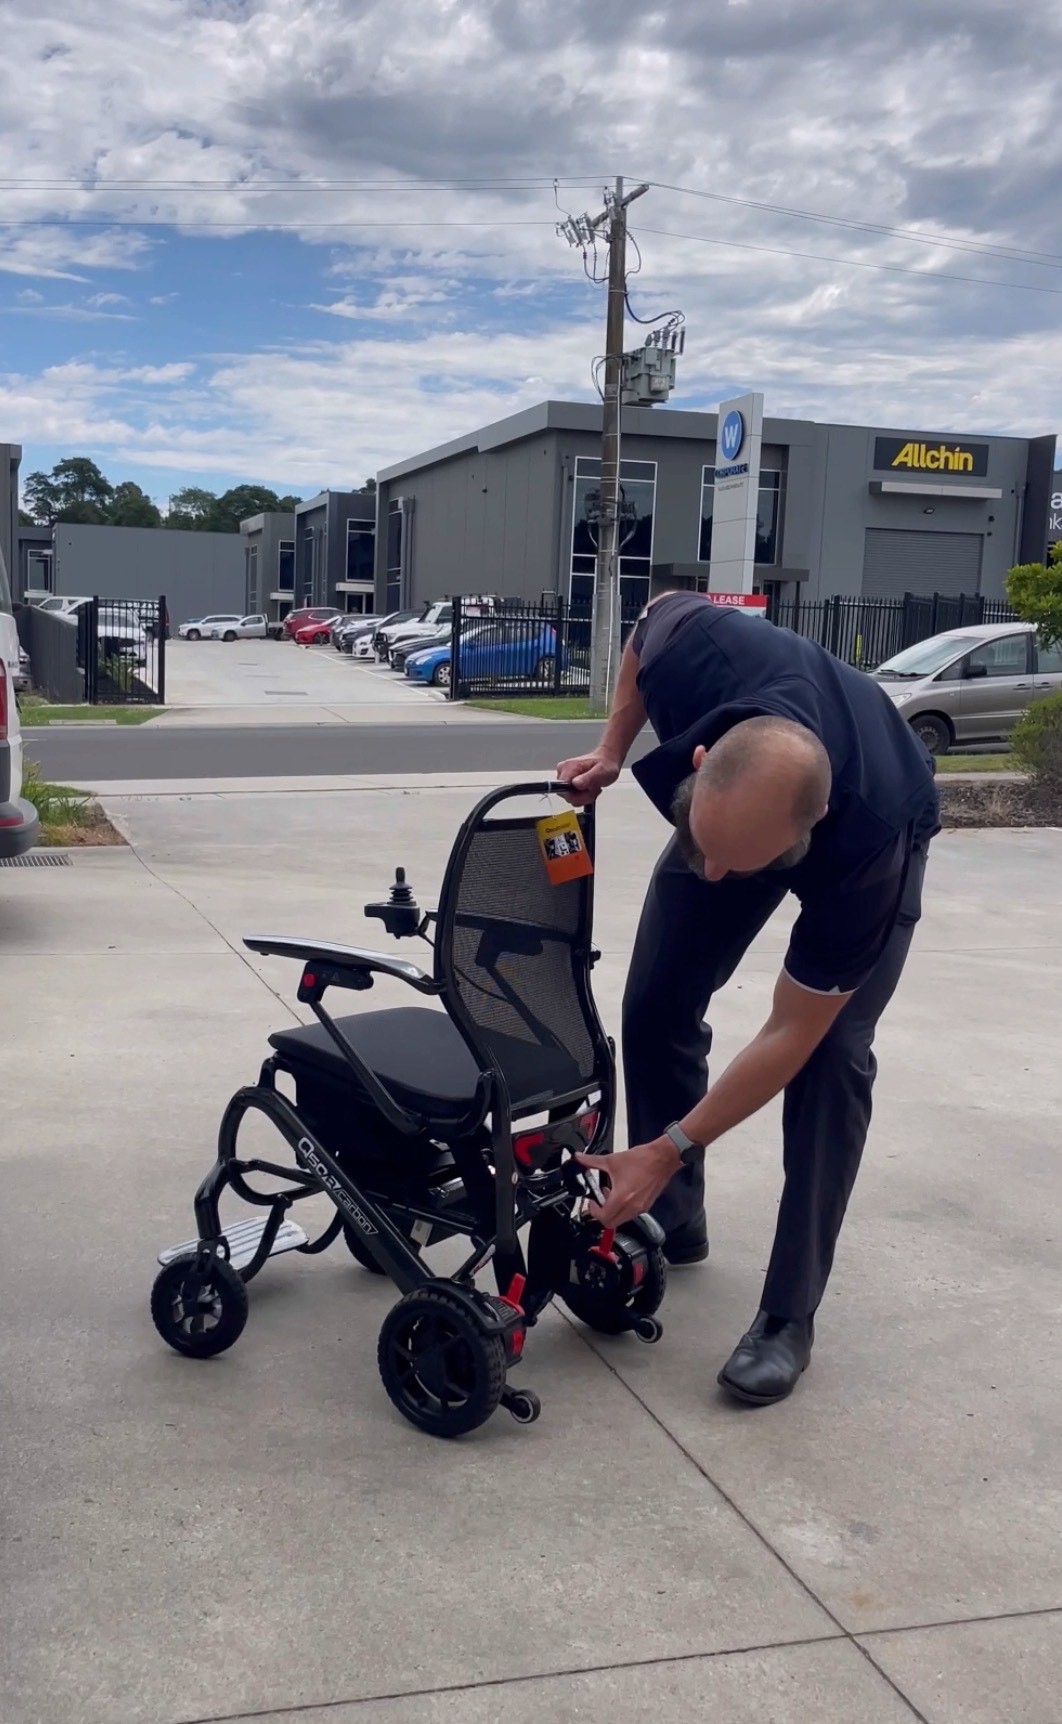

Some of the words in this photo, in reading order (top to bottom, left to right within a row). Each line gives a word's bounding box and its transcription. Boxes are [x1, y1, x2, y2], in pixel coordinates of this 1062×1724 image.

[725, 424, 738, 449] W
[892, 443, 974, 471] Allchin
[713, 595, 745, 605] LEASE
